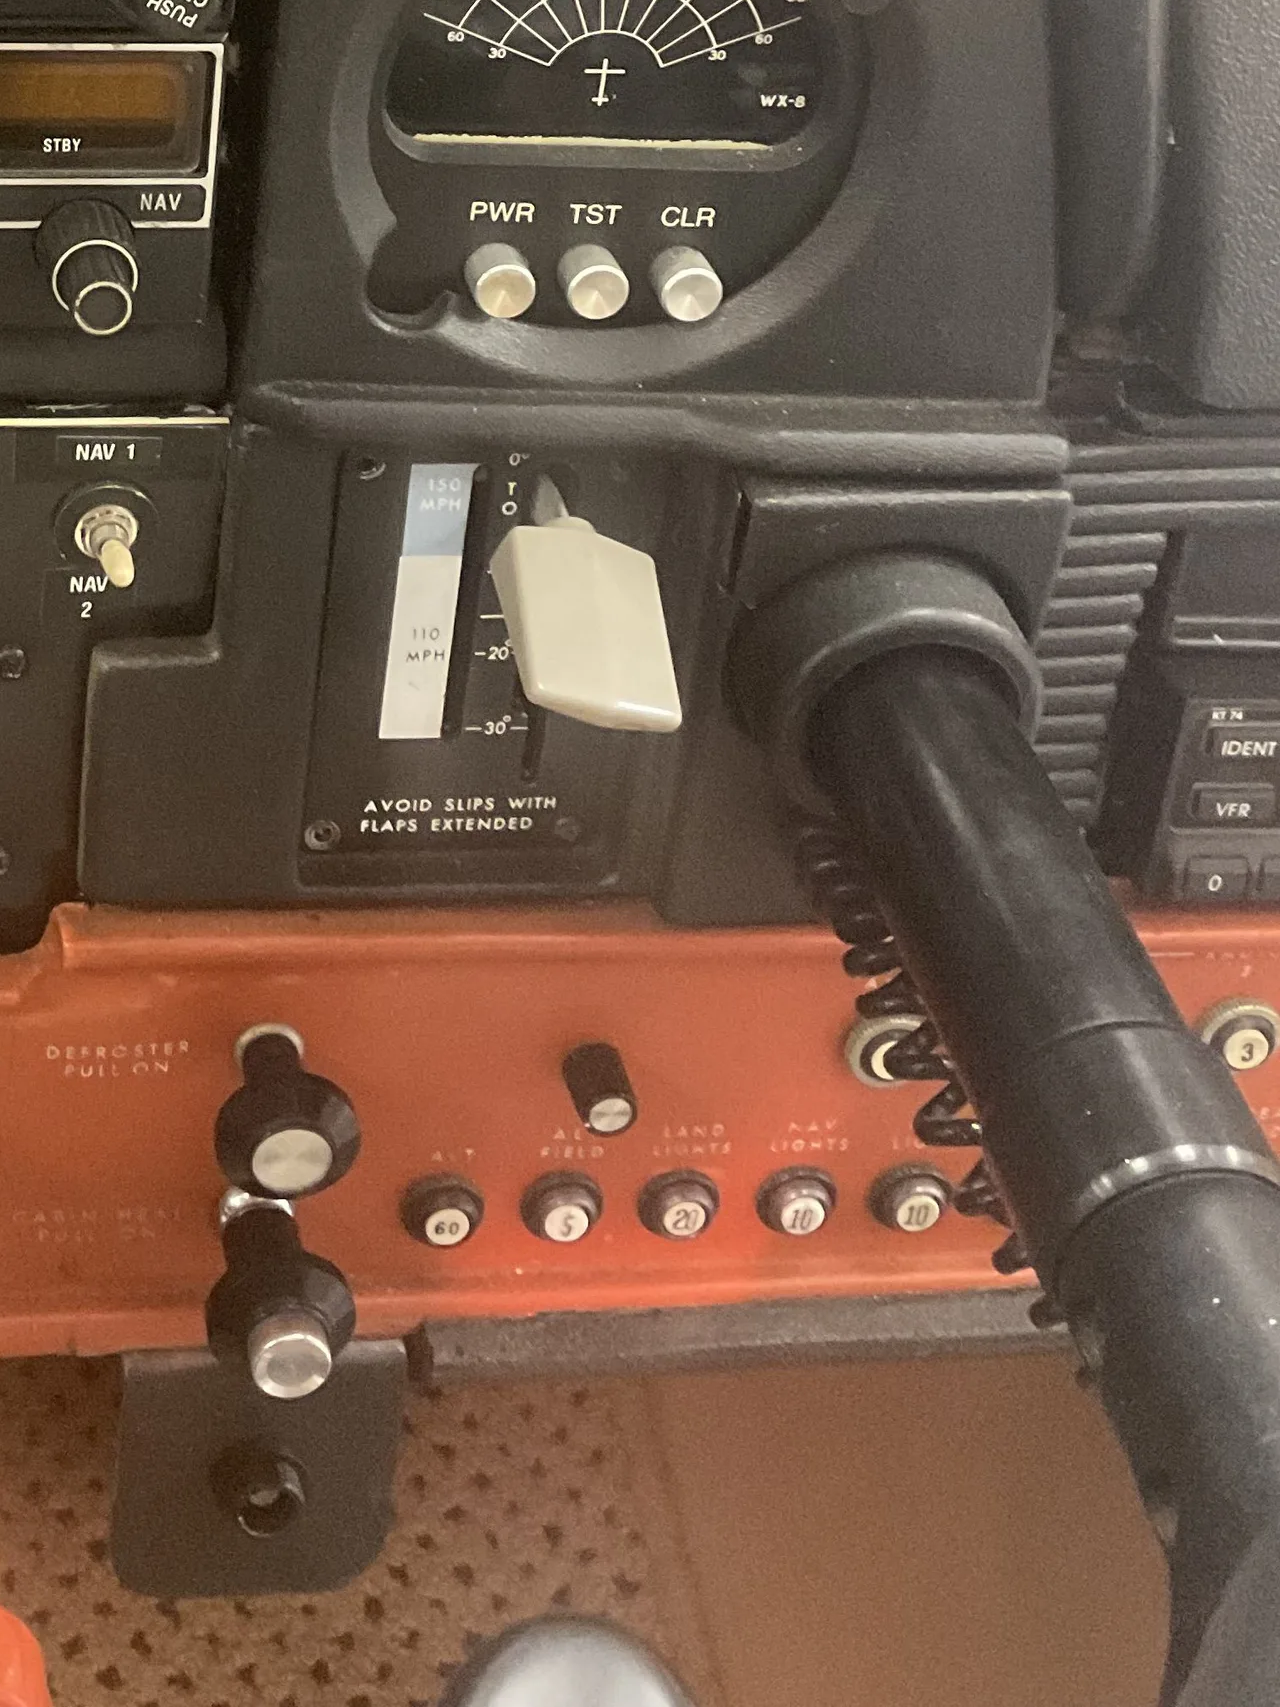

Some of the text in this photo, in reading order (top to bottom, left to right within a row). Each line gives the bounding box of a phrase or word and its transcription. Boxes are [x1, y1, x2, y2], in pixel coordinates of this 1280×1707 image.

[447, 31, 465, 42] 60
[755, 34, 773, 44] 60
[488, 47, 506, 59] 30
[708, 50, 727, 61] 30
[760, 95, 806, 108] WX-8
[43, 138, 81, 152] STBY
[140, 194, 182, 211] NAV
[469, 202, 535, 223] PWR
[570, 204, 622, 225] TST
[660, 207, 715, 227] CLR
[75, 443, 135, 461] NAV 1
[420, 498, 462, 512] MPH
[70, 576, 109, 593] NAV
[80, 601, 93, 618] 2
[406, 648, 446, 663] MPH
[1221, 741, 1278, 757] IDENT
[364, 796, 557, 813] AVOID SLIPS WITH
[1215, 802, 1251, 817] VFR
[360, 817, 533, 833] FLAPS EXTENDED
[45, 1040, 190, 1061] DEFROSTER
[1241, 1042, 1255, 1062] 3
[132, 1060, 170, 1075] ON
[663, 1123, 725, 1138] LAND
[673, 1208, 700, 1231] 20
[788, 1207, 812, 1231] 10
[903, 1201, 929, 1225] 10
[434, 1221, 460, 1236] 60
[560, 1213, 575, 1237] 5
